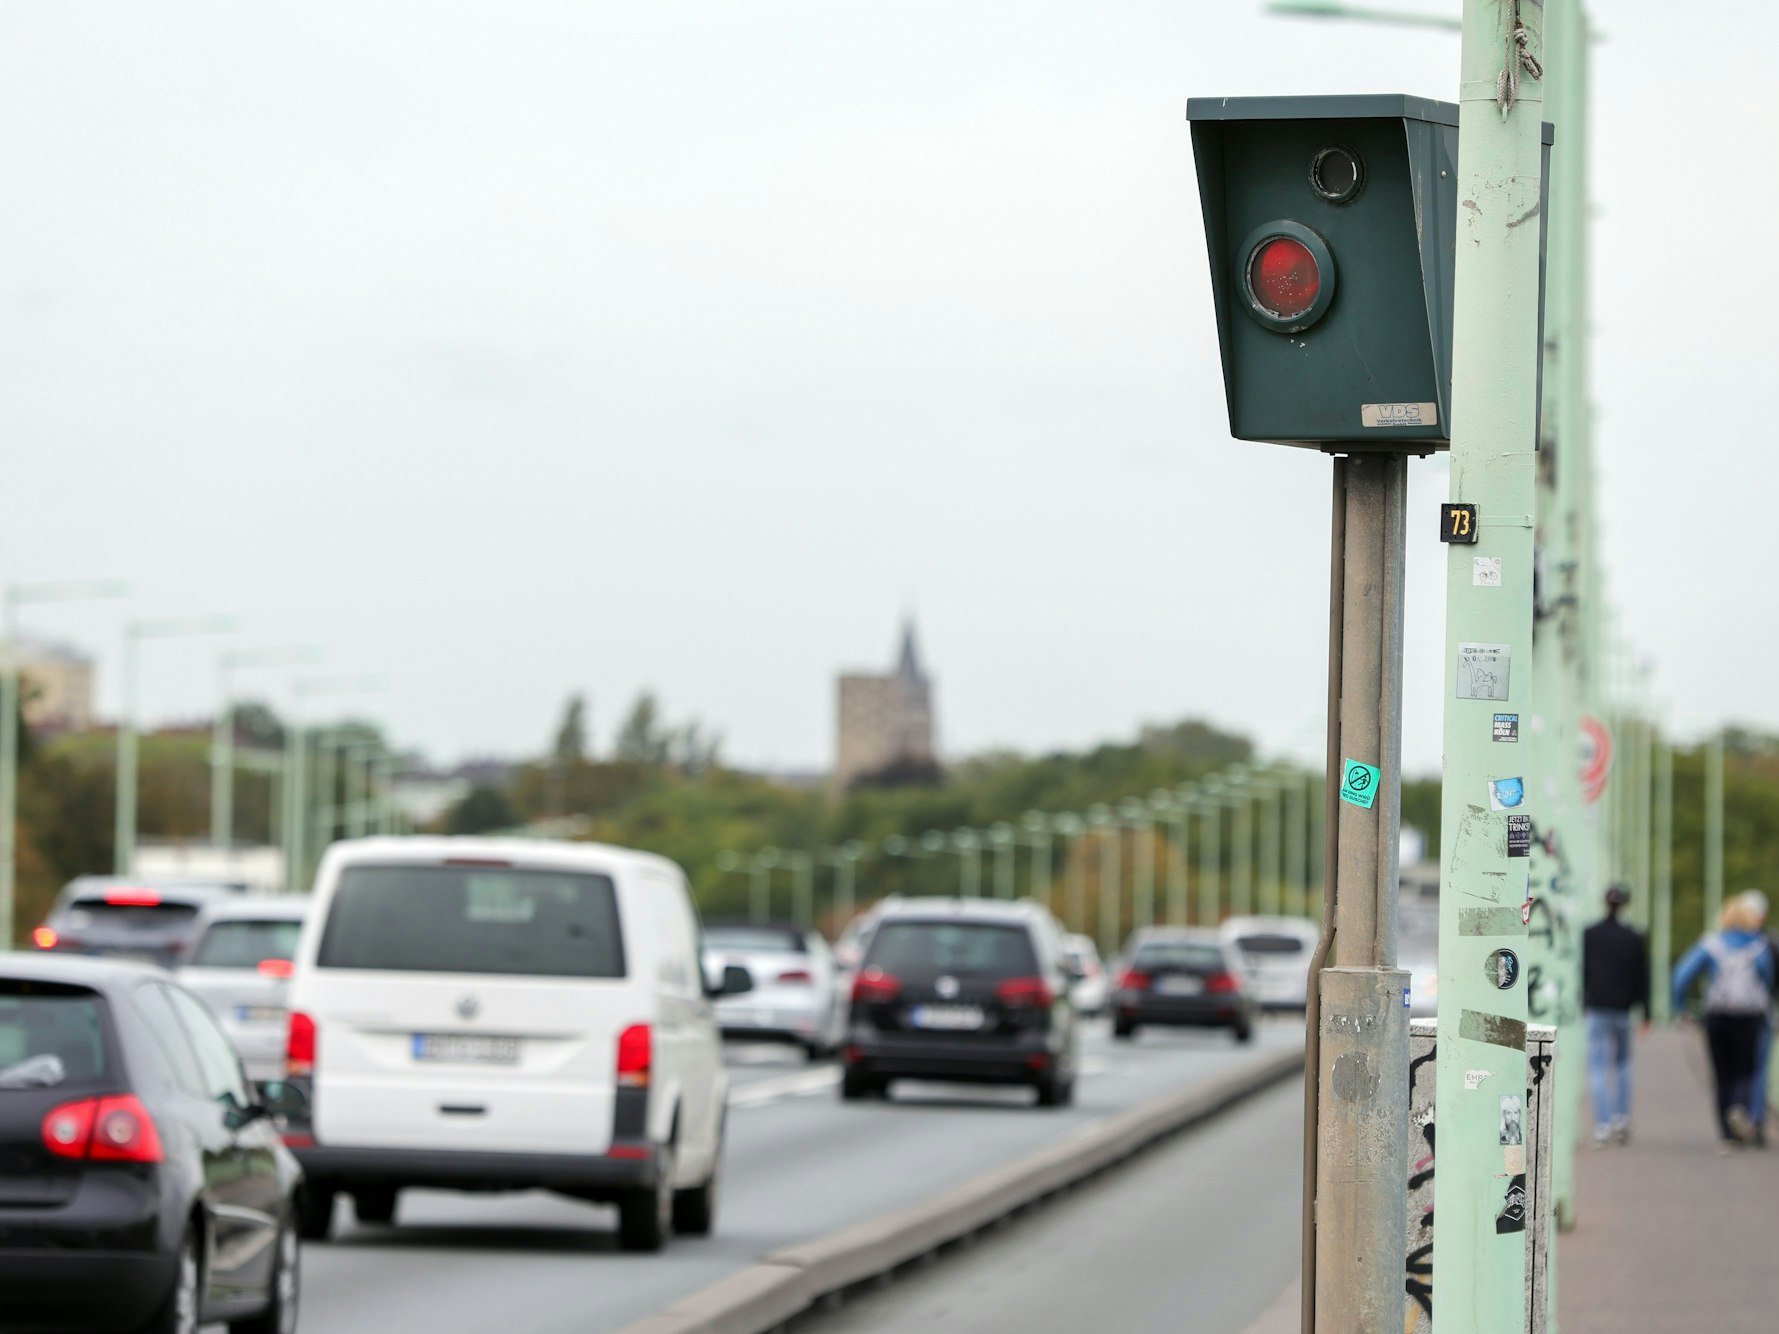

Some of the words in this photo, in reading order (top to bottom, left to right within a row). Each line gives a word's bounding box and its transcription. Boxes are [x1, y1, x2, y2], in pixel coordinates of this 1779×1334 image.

[1379, 404, 1419, 418] VDS
[1450, 510, 1470, 535] 73
[1494, 728, 1510, 736] KÖLN
